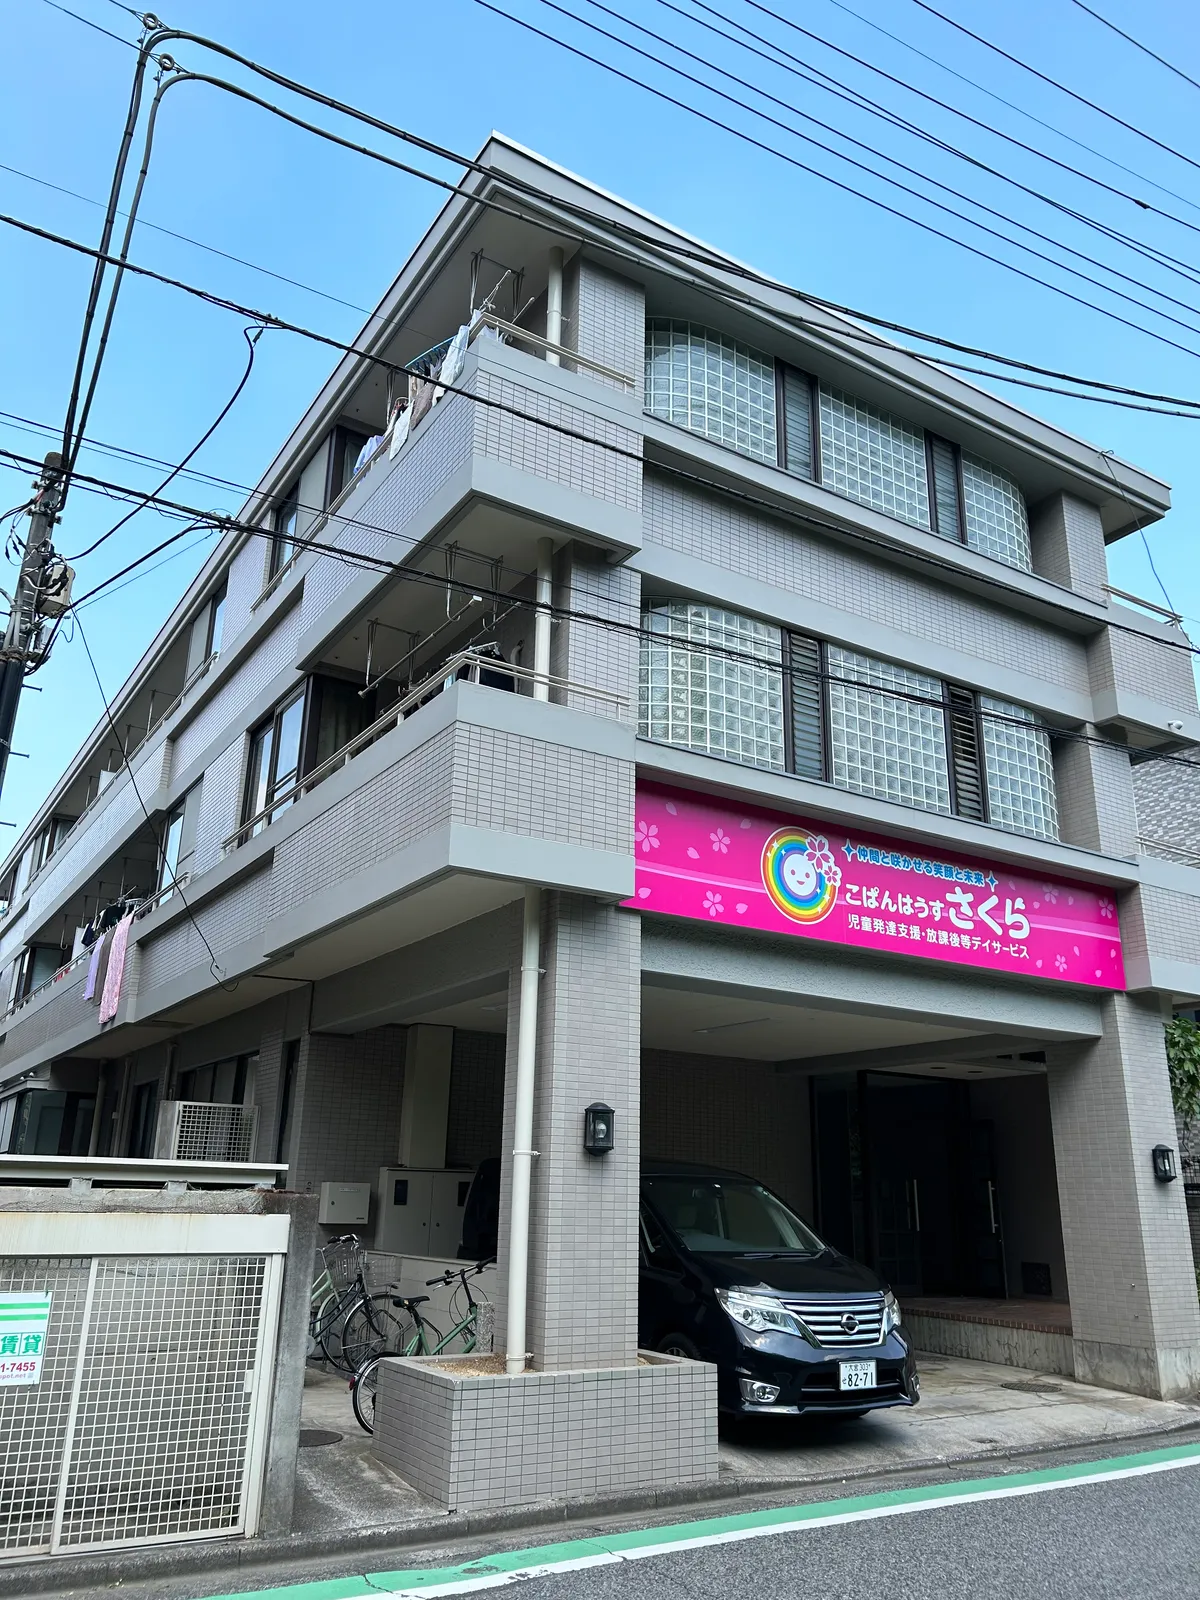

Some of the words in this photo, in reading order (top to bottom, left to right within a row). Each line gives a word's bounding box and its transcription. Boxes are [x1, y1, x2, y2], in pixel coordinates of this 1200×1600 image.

[857, 845, 985, 887] 仲間と咲かせる笑顔と未来
[848, 913, 1030, 959] 児童発達支援・放課後等デイサービス
[847, 1372, 873, 1387] 82-71
